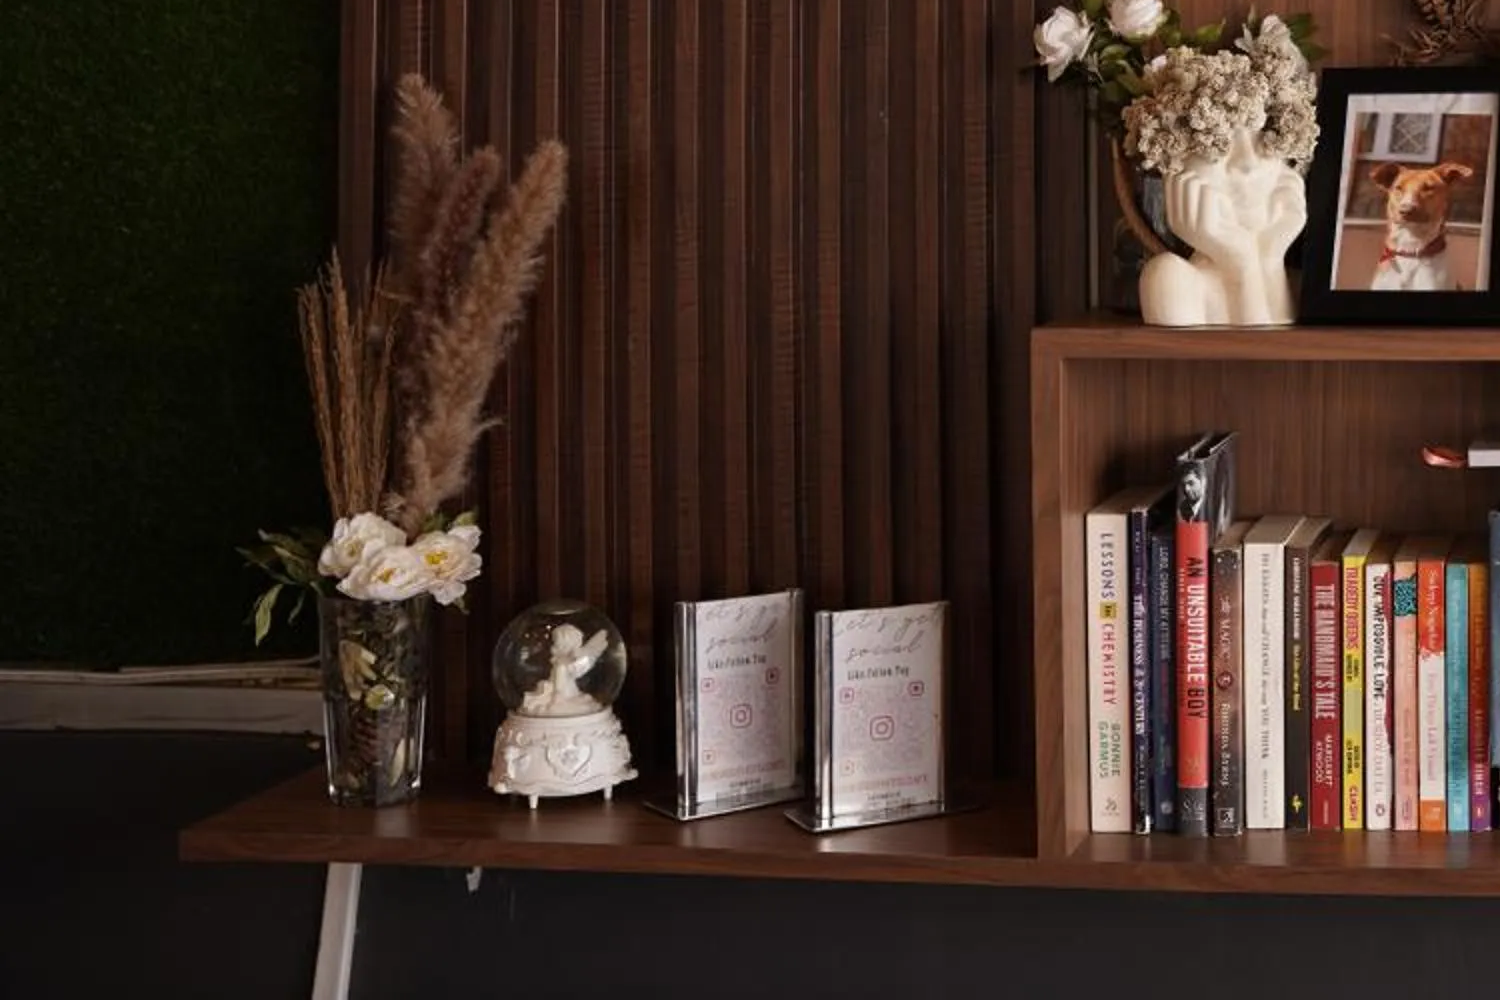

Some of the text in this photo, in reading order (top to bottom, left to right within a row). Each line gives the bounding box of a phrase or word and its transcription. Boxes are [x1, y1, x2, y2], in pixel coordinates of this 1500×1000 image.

[1100, 532, 1117, 706] LESSONS CHEMISTRY
[1187, 556, 1206, 719] AN UNSUITABLE BOY
[1315, 584, 1336, 720] THE HANDMAID'S TALE
[1373, 597, 1386, 668] IMPOSSIBLE
[1099, 720, 1110, 779] GARMUS
[1111, 722, 1122, 777] BONNIE
[1324, 733, 1334, 787] MARGARET
